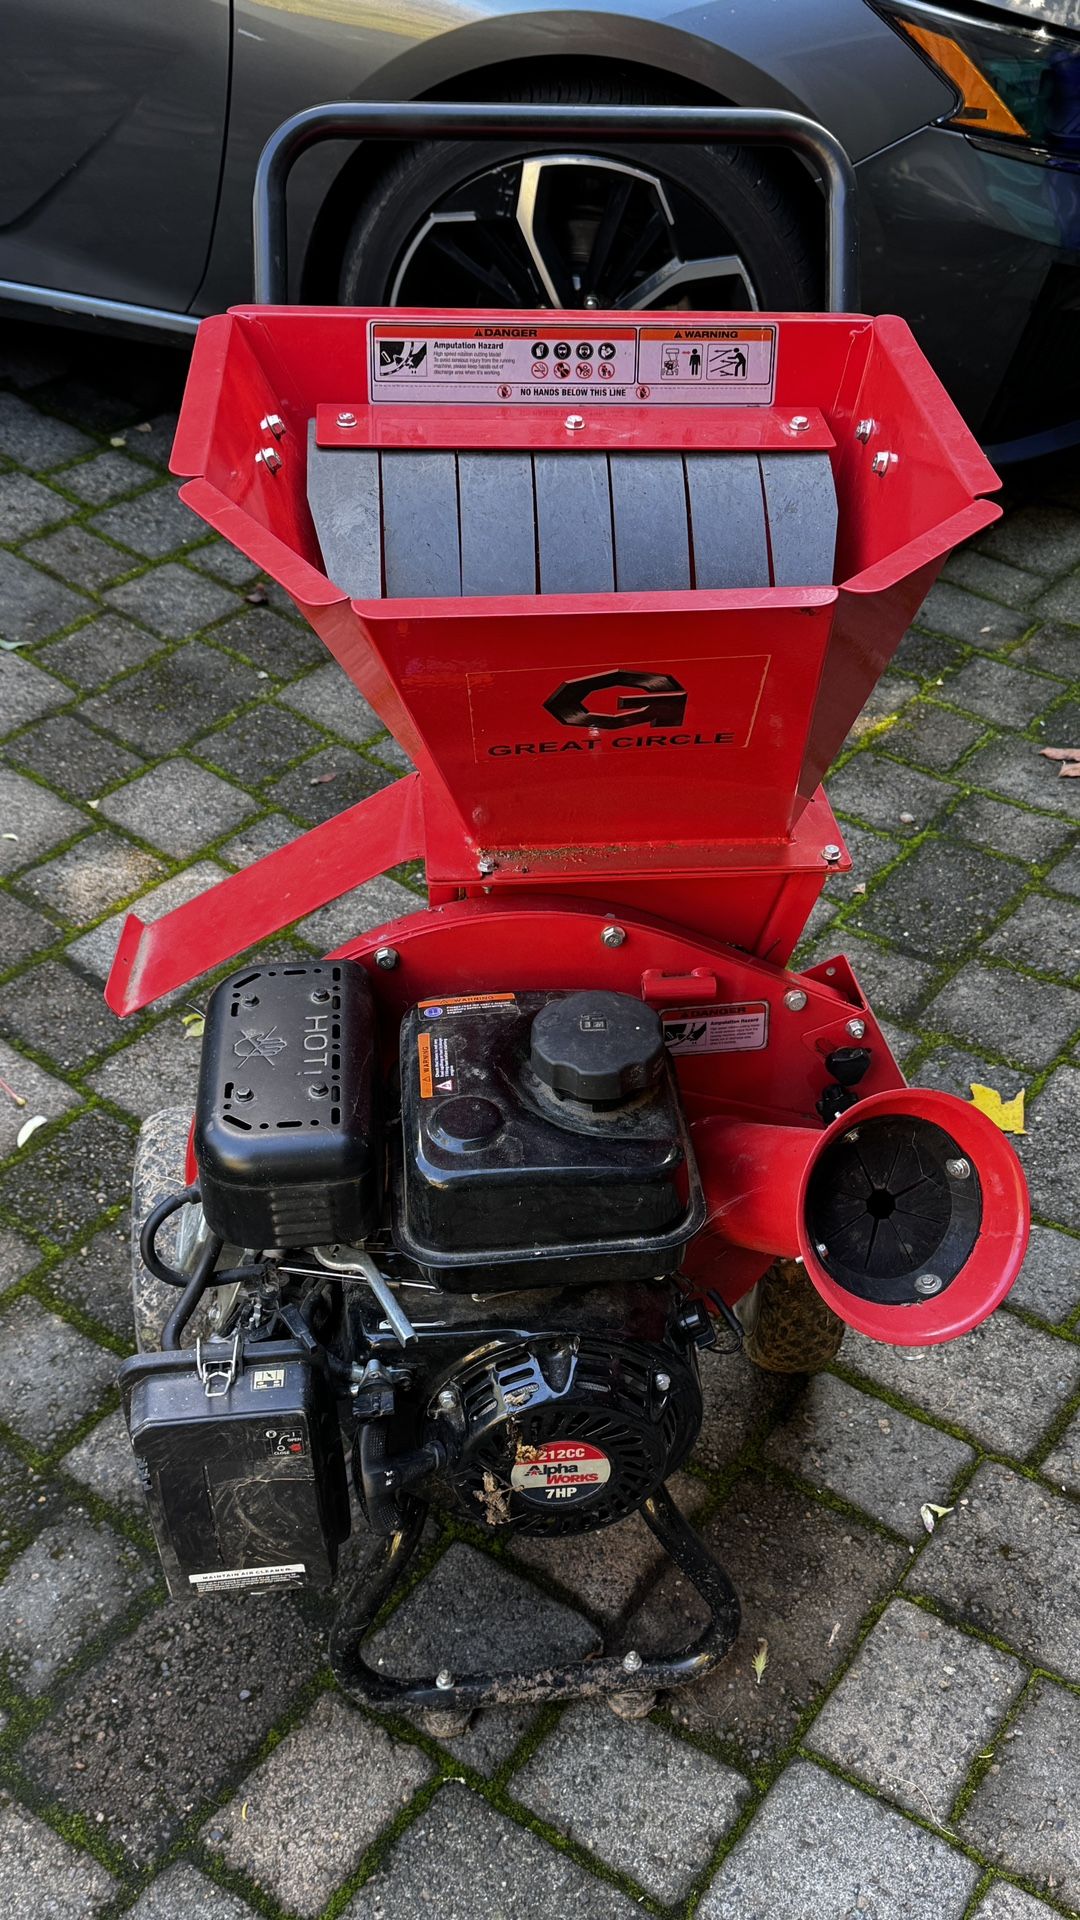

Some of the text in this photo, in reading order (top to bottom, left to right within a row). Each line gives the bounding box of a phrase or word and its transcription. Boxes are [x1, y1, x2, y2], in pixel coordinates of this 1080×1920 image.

[484, 329, 538, 338] DANGER
[684, 330, 738, 338] WARNING
[434, 342, 476, 350] Amputation
[488, 732, 736, 756] GREAT CIRCLE
[691, 1006, 746, 1018] DANGER
[540, 1448, 585, 1460] 212CC
[524, 1464, 578, 1478] Alpha
[546, 1473, 598, 1484] WORKS
[545, 1487, 577, 1499] 7HP
